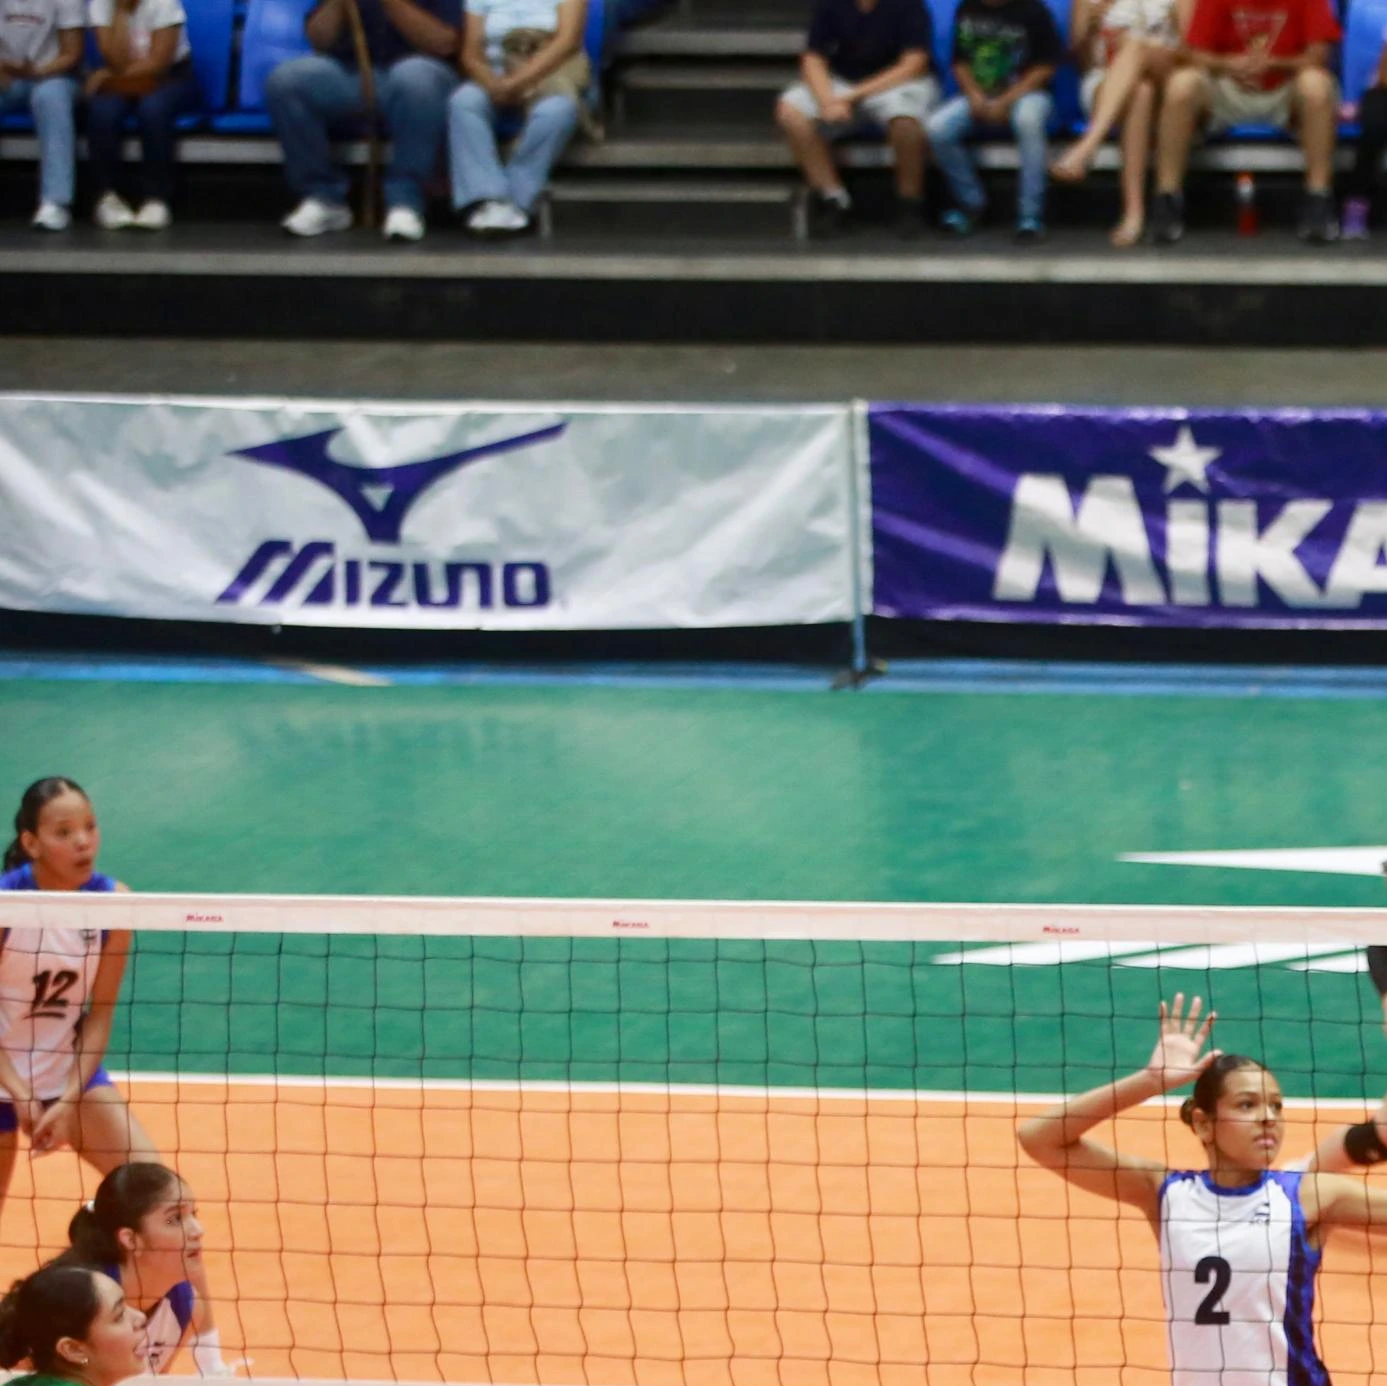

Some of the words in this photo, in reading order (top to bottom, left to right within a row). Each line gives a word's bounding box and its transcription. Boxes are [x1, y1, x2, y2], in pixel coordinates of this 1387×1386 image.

[216, 539, 551, 609] MIZUNO
[31, 969, 77, 1010] 12
[1194, 1255, 1231, 1326] 2
